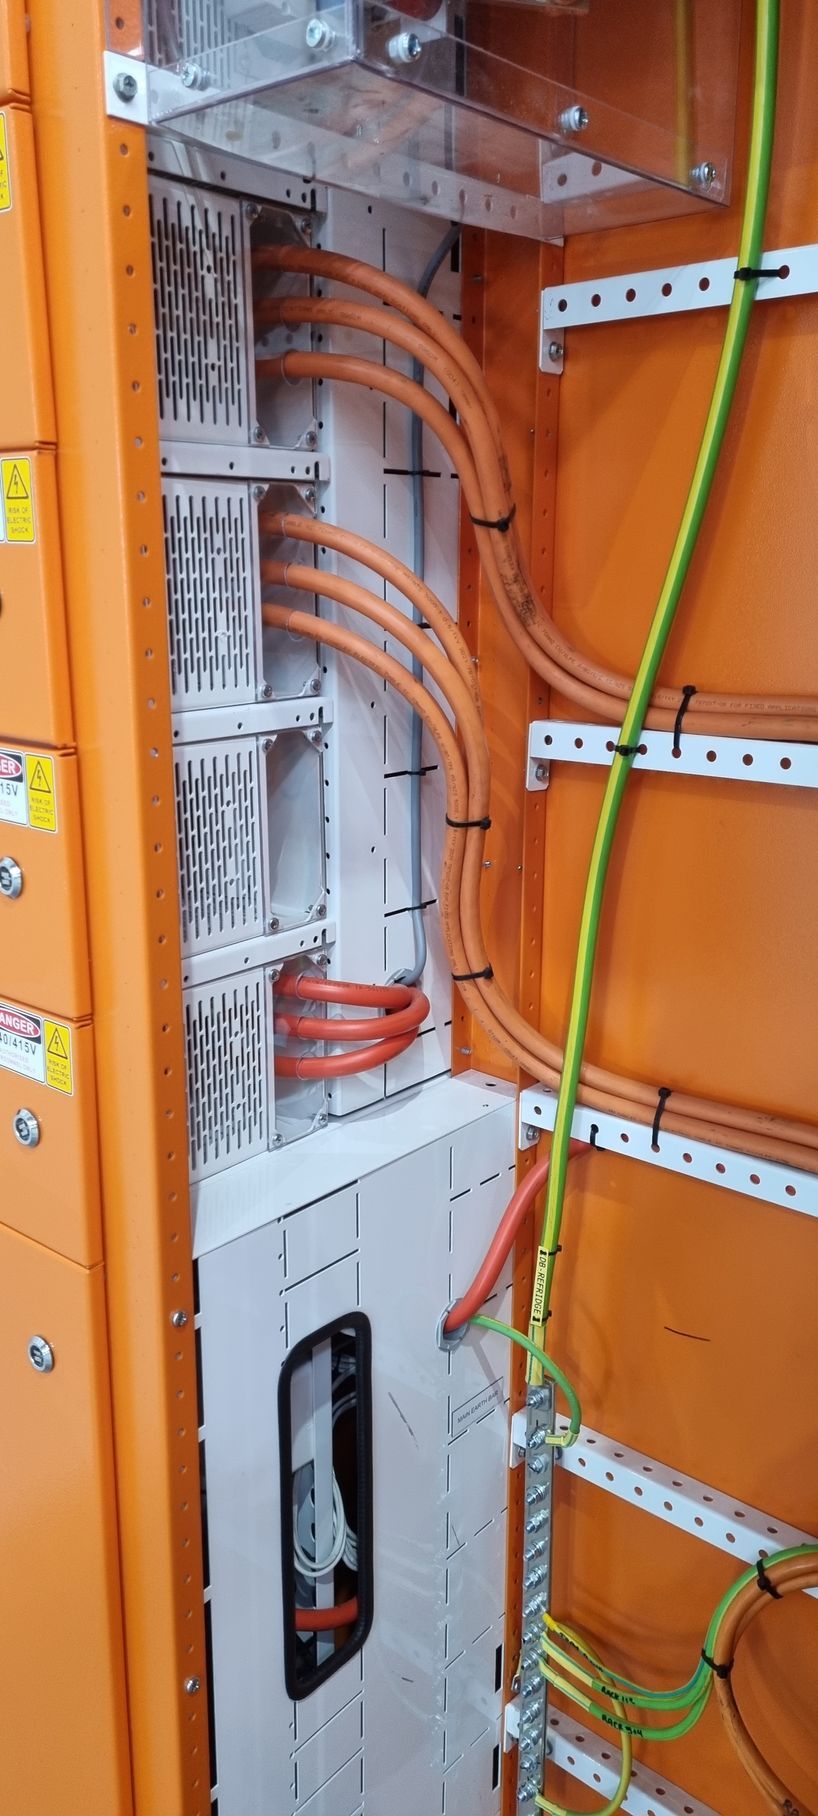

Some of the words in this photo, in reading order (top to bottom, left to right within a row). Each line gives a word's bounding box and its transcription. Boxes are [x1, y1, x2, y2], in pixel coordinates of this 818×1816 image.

[533, 1256, 547, 1316] DB-REFRIDGE
[457, 1410, 471, 1423] MAIN
[471, 1397, 488, 1414] EARTH
[488, 1390, 499, 1402] BAR
